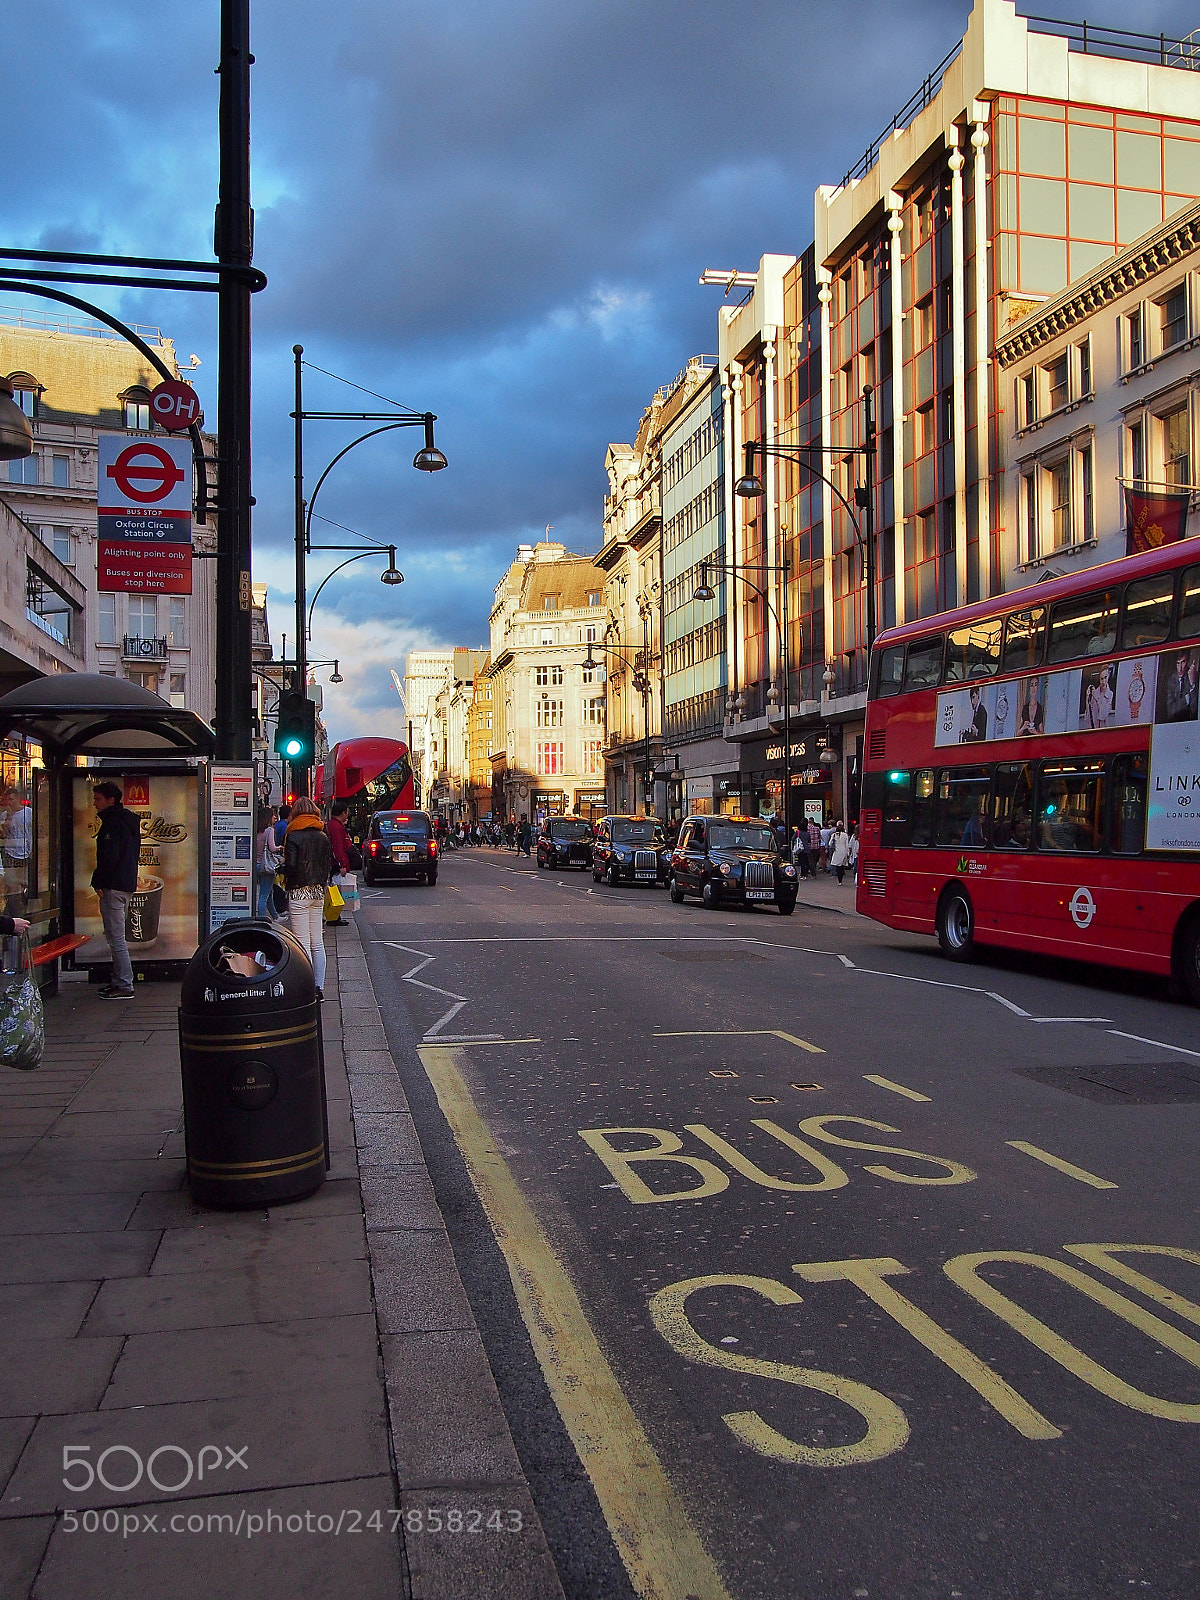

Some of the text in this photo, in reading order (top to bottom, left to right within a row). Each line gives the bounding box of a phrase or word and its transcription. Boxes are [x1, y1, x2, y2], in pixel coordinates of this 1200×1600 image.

[153, 393, 195, 418] OH
[115, 520, 174, 529] Oxford Circus
[124, 529, 154, 537] Station
[104, 548, 141, 558] Alighting
[168, 552, 186, 560] only
[106, 568, 131, 577] Buses
[146, 571, 184, 579] diversion
[146, 580, 165, 588] here
[805, 804, 821, 813] £99
[220, 988, 267, 1000] general litter
[578, 1115, 978, 1205] BUS
